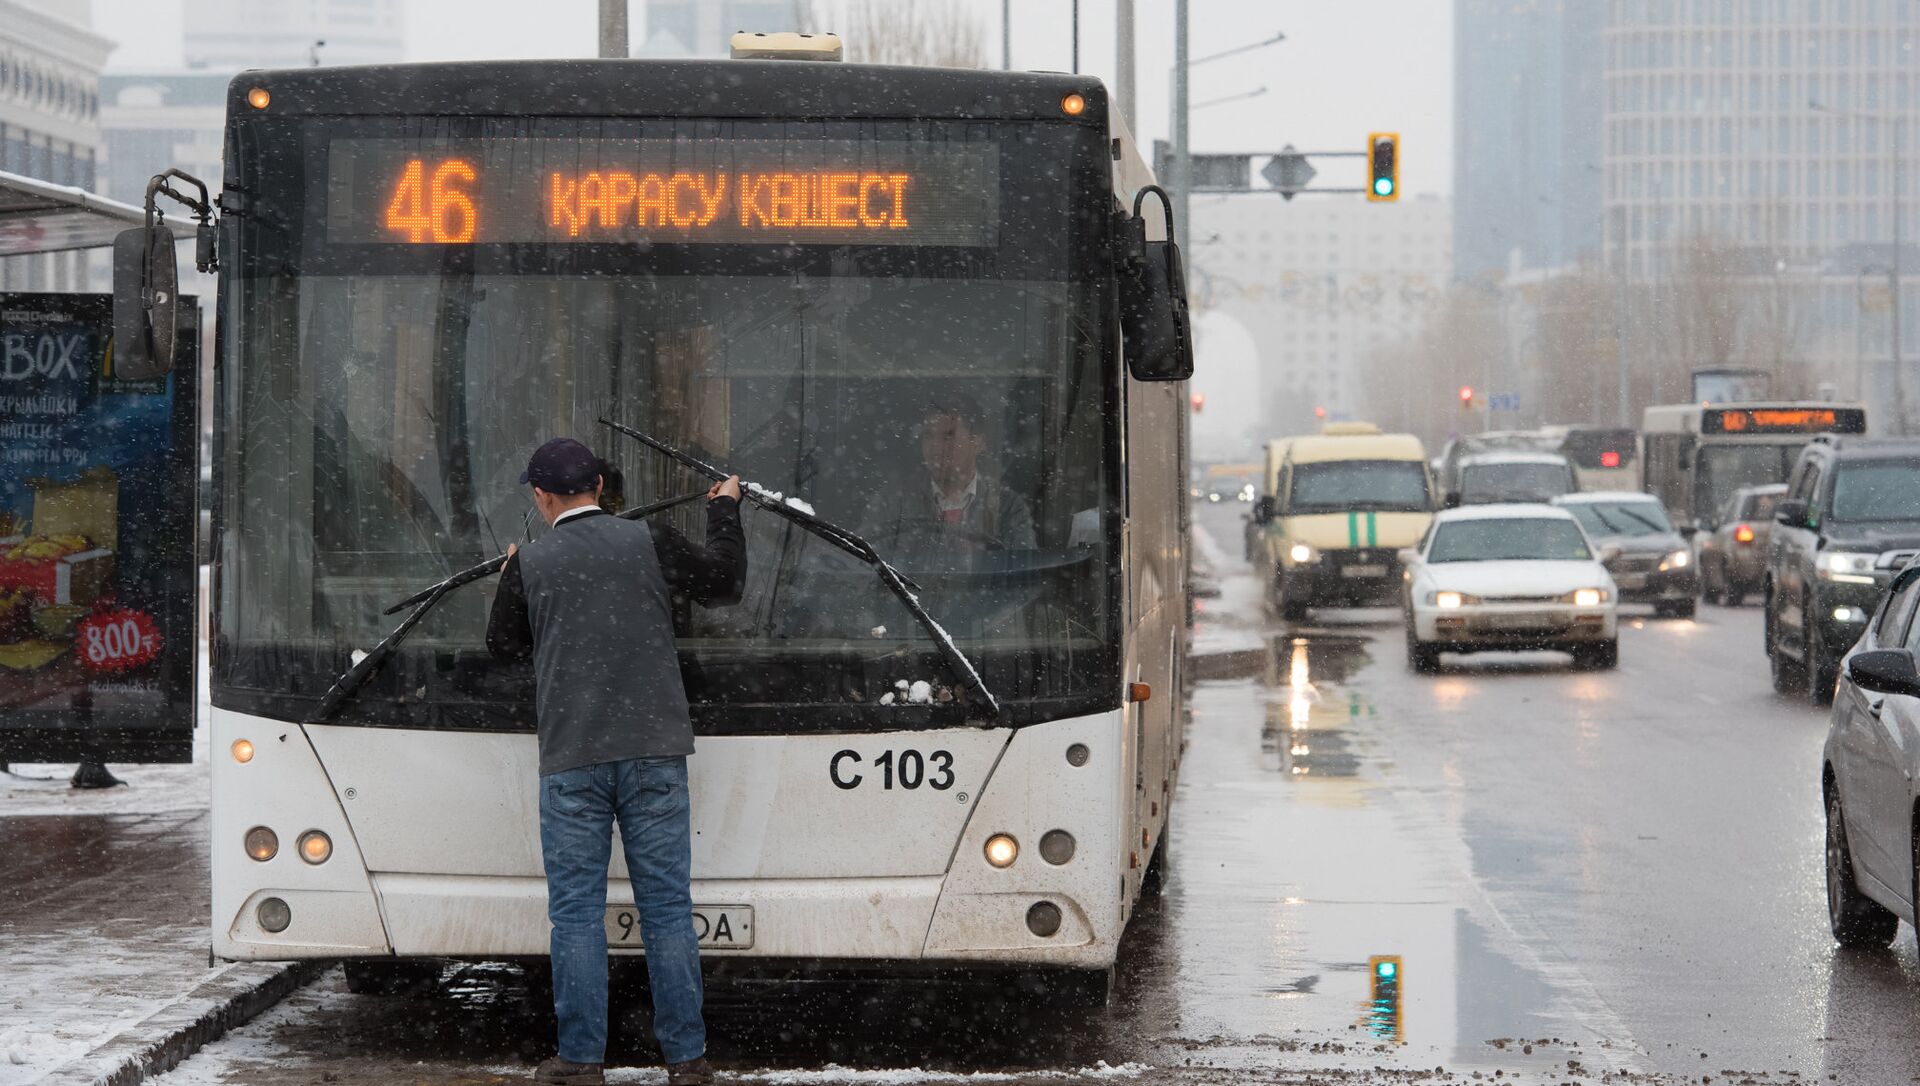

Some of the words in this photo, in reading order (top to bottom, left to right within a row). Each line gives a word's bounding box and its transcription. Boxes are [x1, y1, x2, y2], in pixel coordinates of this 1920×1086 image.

[386, 159, 476, 243] 46
[1, 334, 78, 380] BOX
[830, 749, 863, 790] C
[874, 749, 956, 790] 103
